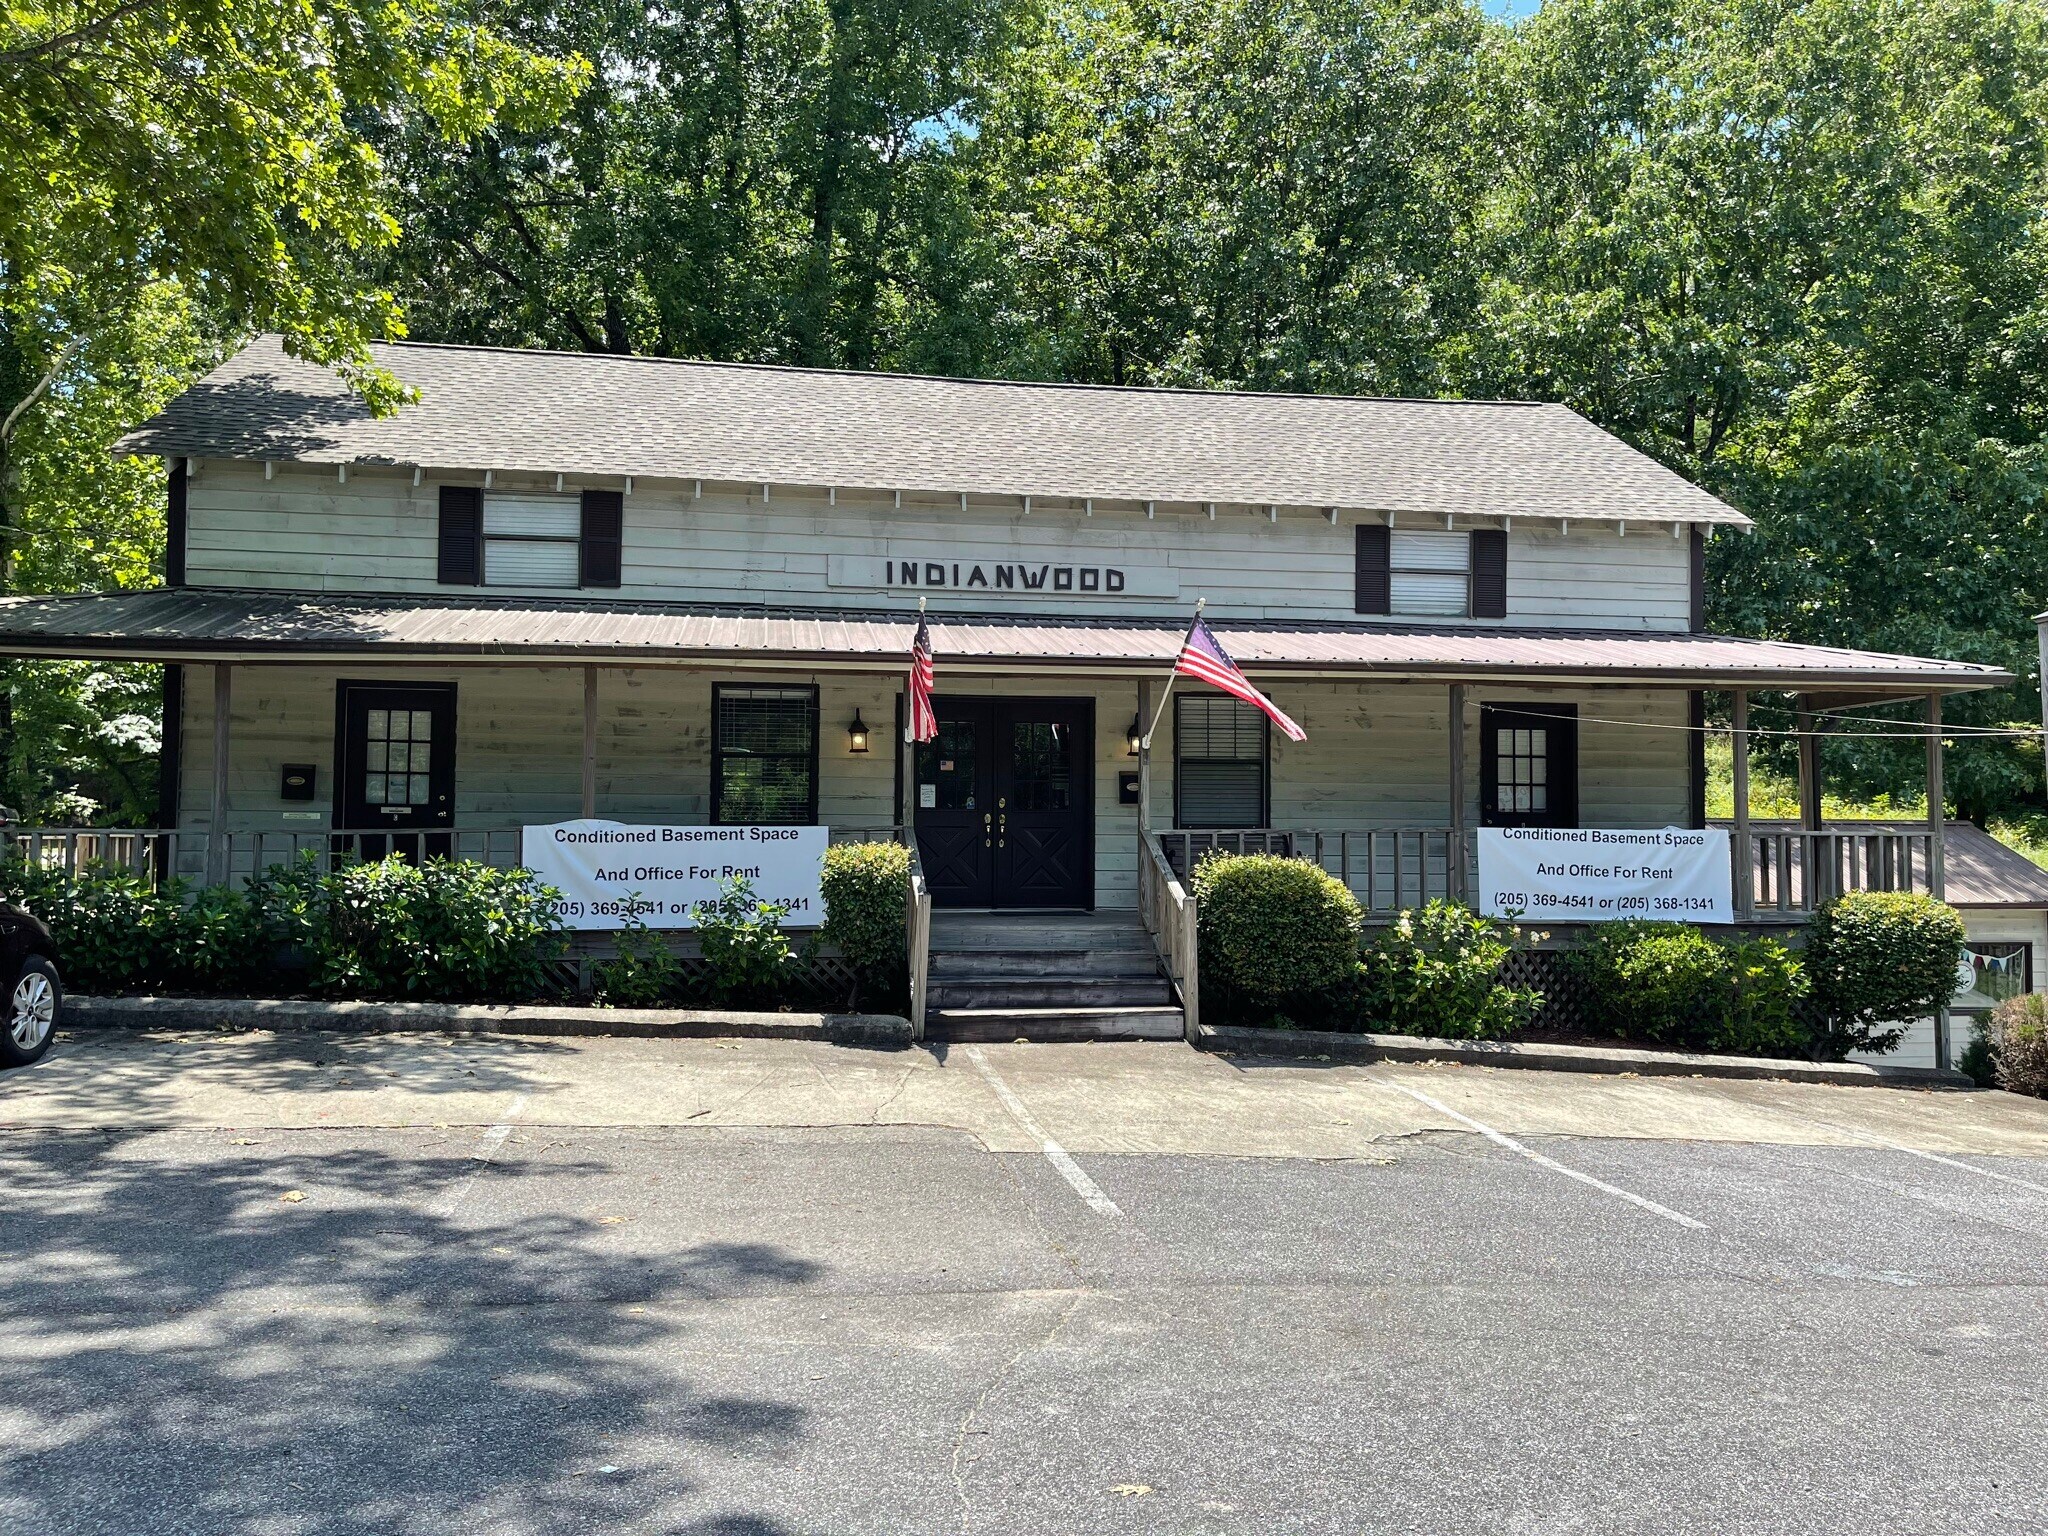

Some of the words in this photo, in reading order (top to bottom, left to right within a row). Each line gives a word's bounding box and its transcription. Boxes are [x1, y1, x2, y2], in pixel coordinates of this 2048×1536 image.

[886, 561, 1125, 591] INDIANWOOD
[555, 829, 656, 843] Conditioned
[662, 828, 745, 842] Basement
[750, 827, 799, 843] Space
[1503, 827, 1587, 842] Conditioned
[1592, 831, 1660, 844] Basement
[1664, 833, 1704, 847] Space
[594, 868, 629, 881] And
[634, 867, 684, 881] Office
[689, 866, 717, 879] For
[722, 865, 760, 878] Rent
[1537, 863, 1565, 876] And
[1569, 864, 1609, 877] Office
[1614, 866, 1637, 878] For
[1641, 867, 1673, 879] Rent
[1494, 892, 1528, 908] (205)
[1532, 894, 1594, 907] 369-4541
[1599, 899, 1614, 908] or
[1617, 897, 1649, 911] (205)
[1653, 897, 1714, 910] 368-1341
[546, 902, 585, 918] 205)
[670, 904, 688, 915] or
